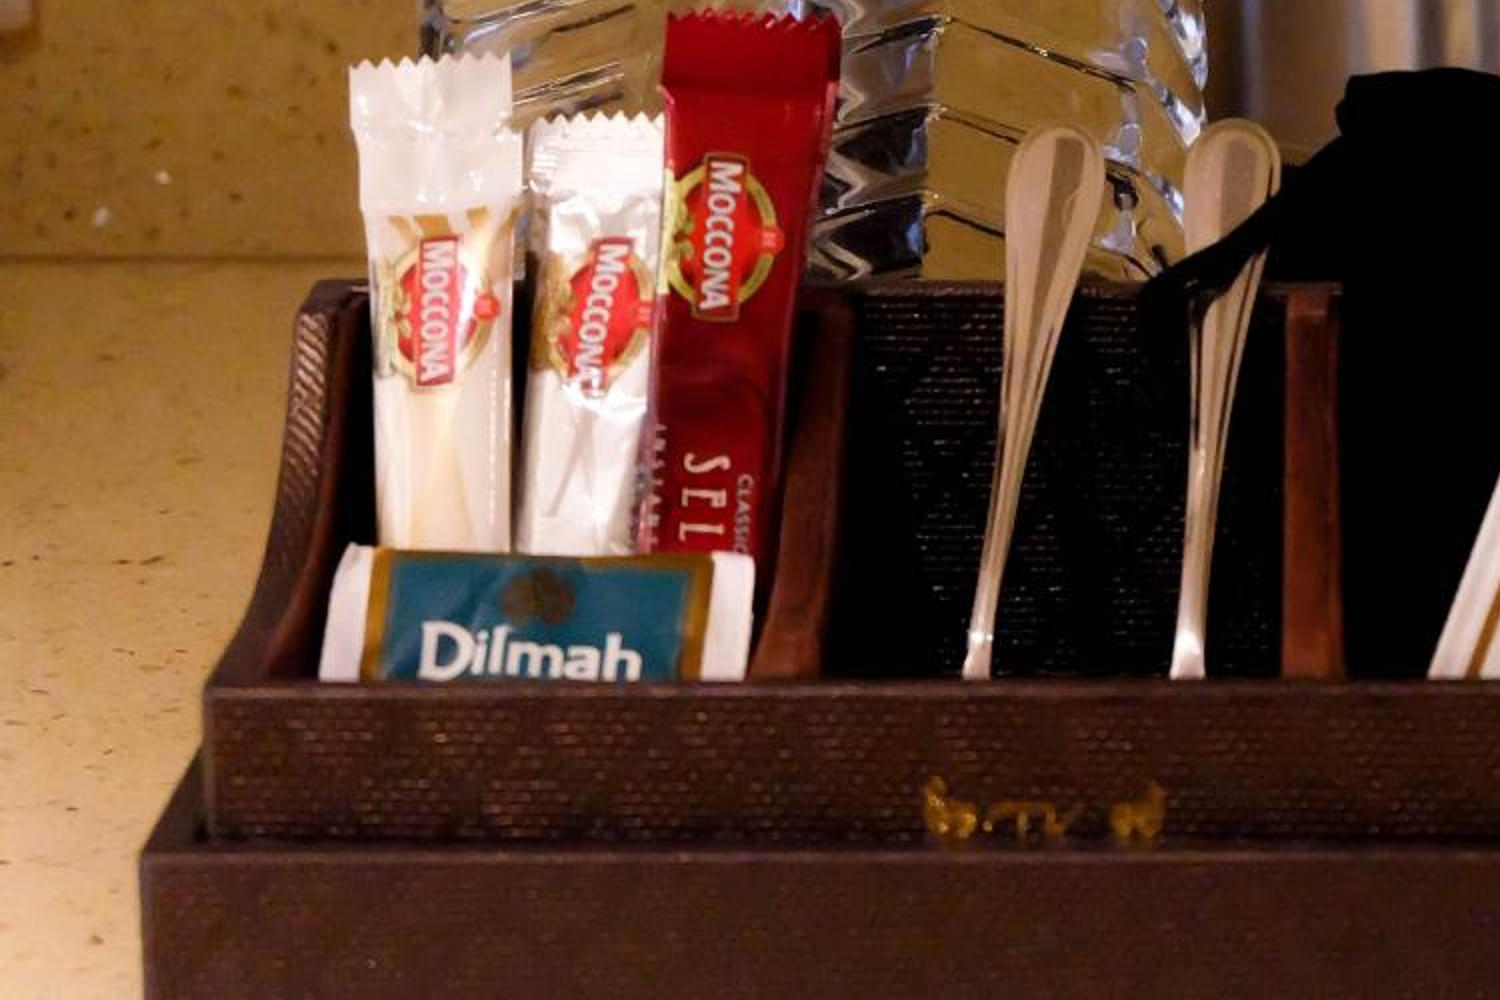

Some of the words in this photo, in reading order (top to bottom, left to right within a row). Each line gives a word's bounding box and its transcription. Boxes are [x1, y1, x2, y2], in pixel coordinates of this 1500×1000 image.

[701, 161, 744, 311] MOCCONA
[419, 239, 458, 378] MOCCONA
[678, 451, 732, 542] SEL
[416, 619, 643, 682] Dilmah
